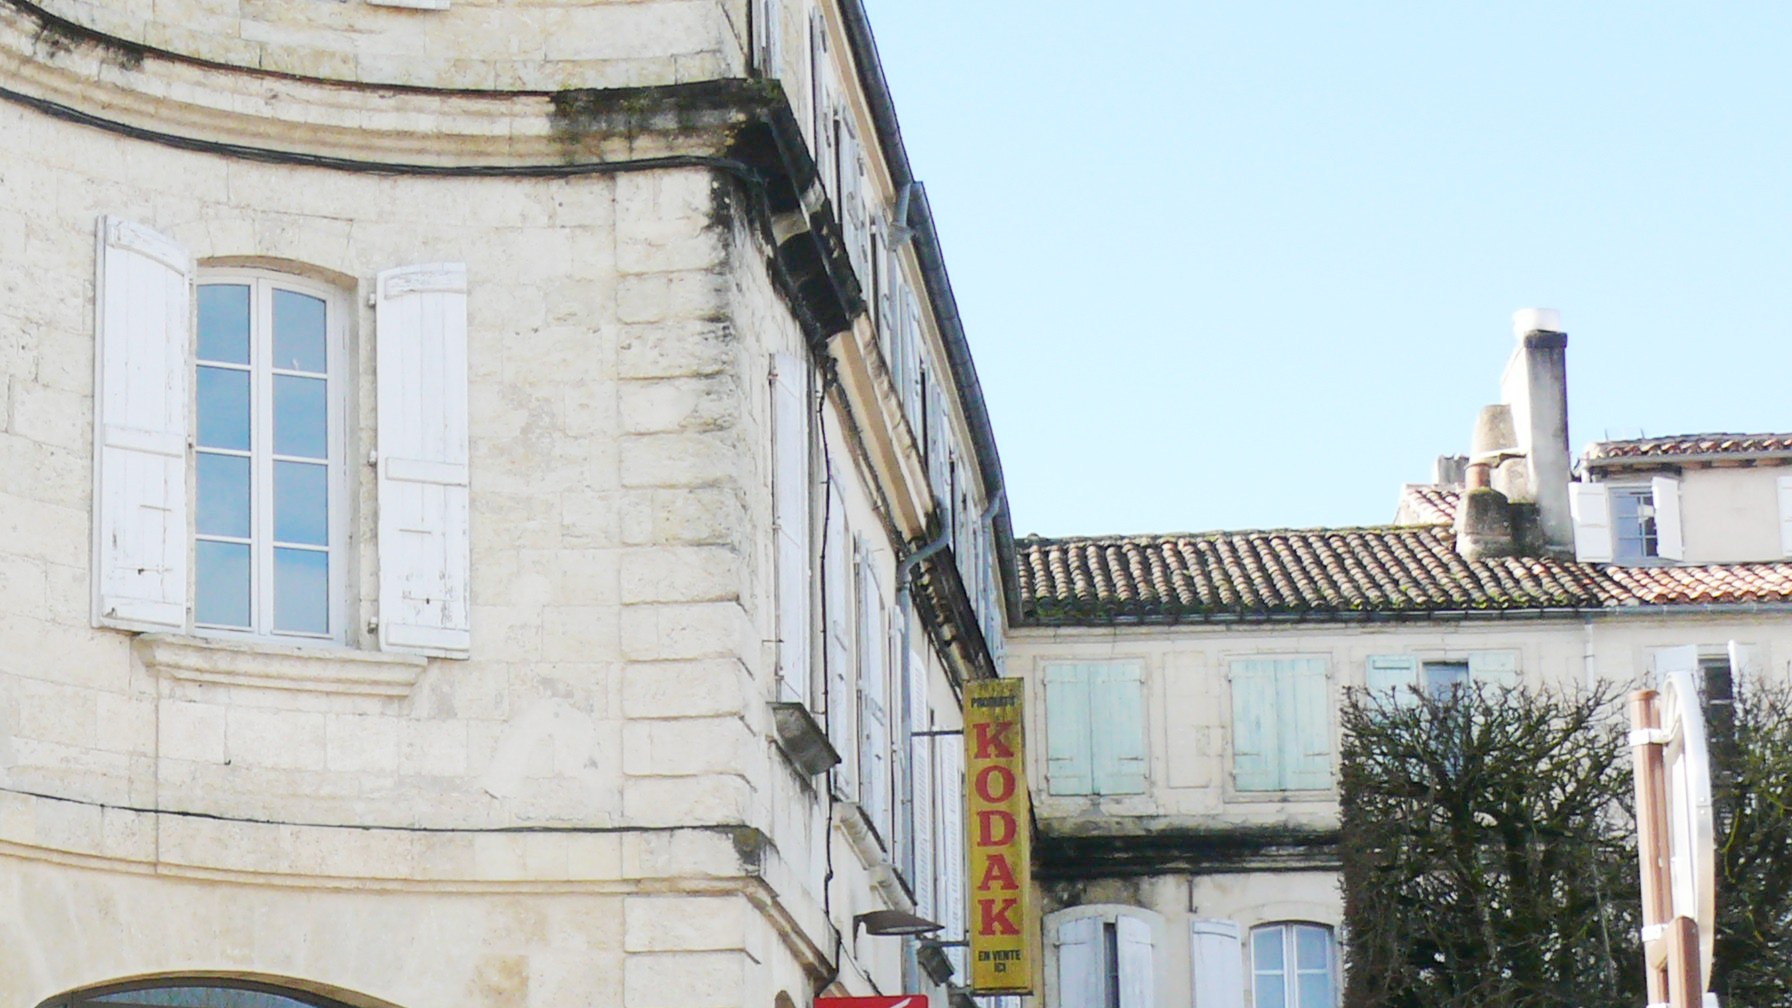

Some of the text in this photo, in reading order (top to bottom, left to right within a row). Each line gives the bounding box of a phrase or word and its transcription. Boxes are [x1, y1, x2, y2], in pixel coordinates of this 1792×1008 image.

[972, 720, 1021, 937] KODAK
[978, 949, 1021, 962] EN VENTE
[994, 961, 1007, 973] ICI
